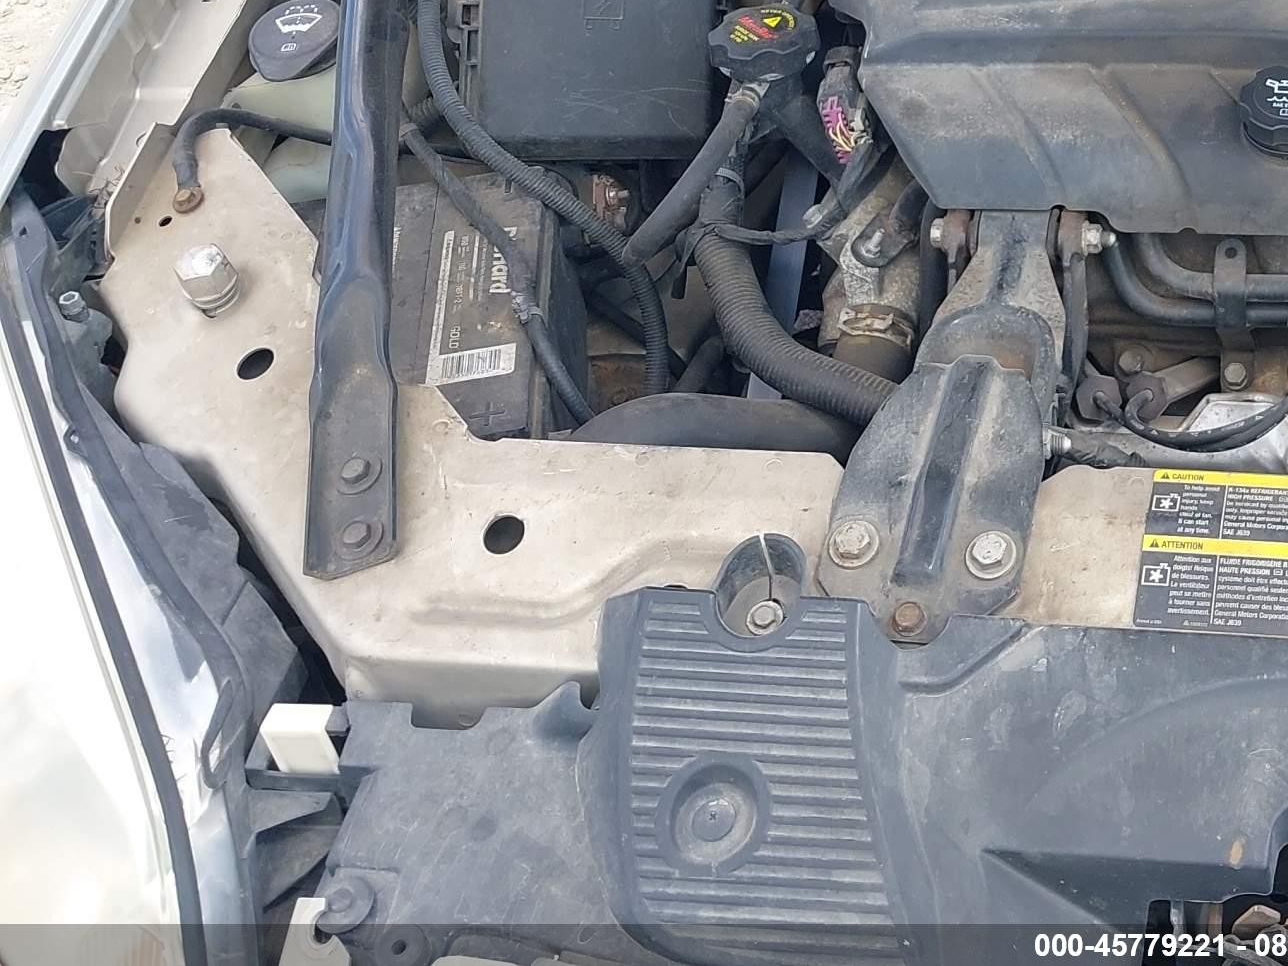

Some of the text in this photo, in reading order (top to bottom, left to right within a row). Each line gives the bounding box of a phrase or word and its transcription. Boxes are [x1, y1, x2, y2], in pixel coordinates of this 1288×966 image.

[489, 226, 517, 294] DHard
[448, 325, 462, 349] GOLD
[1161, 540, 1203, 549] ATTENTION
[1214, 609, 1237, 617] General
